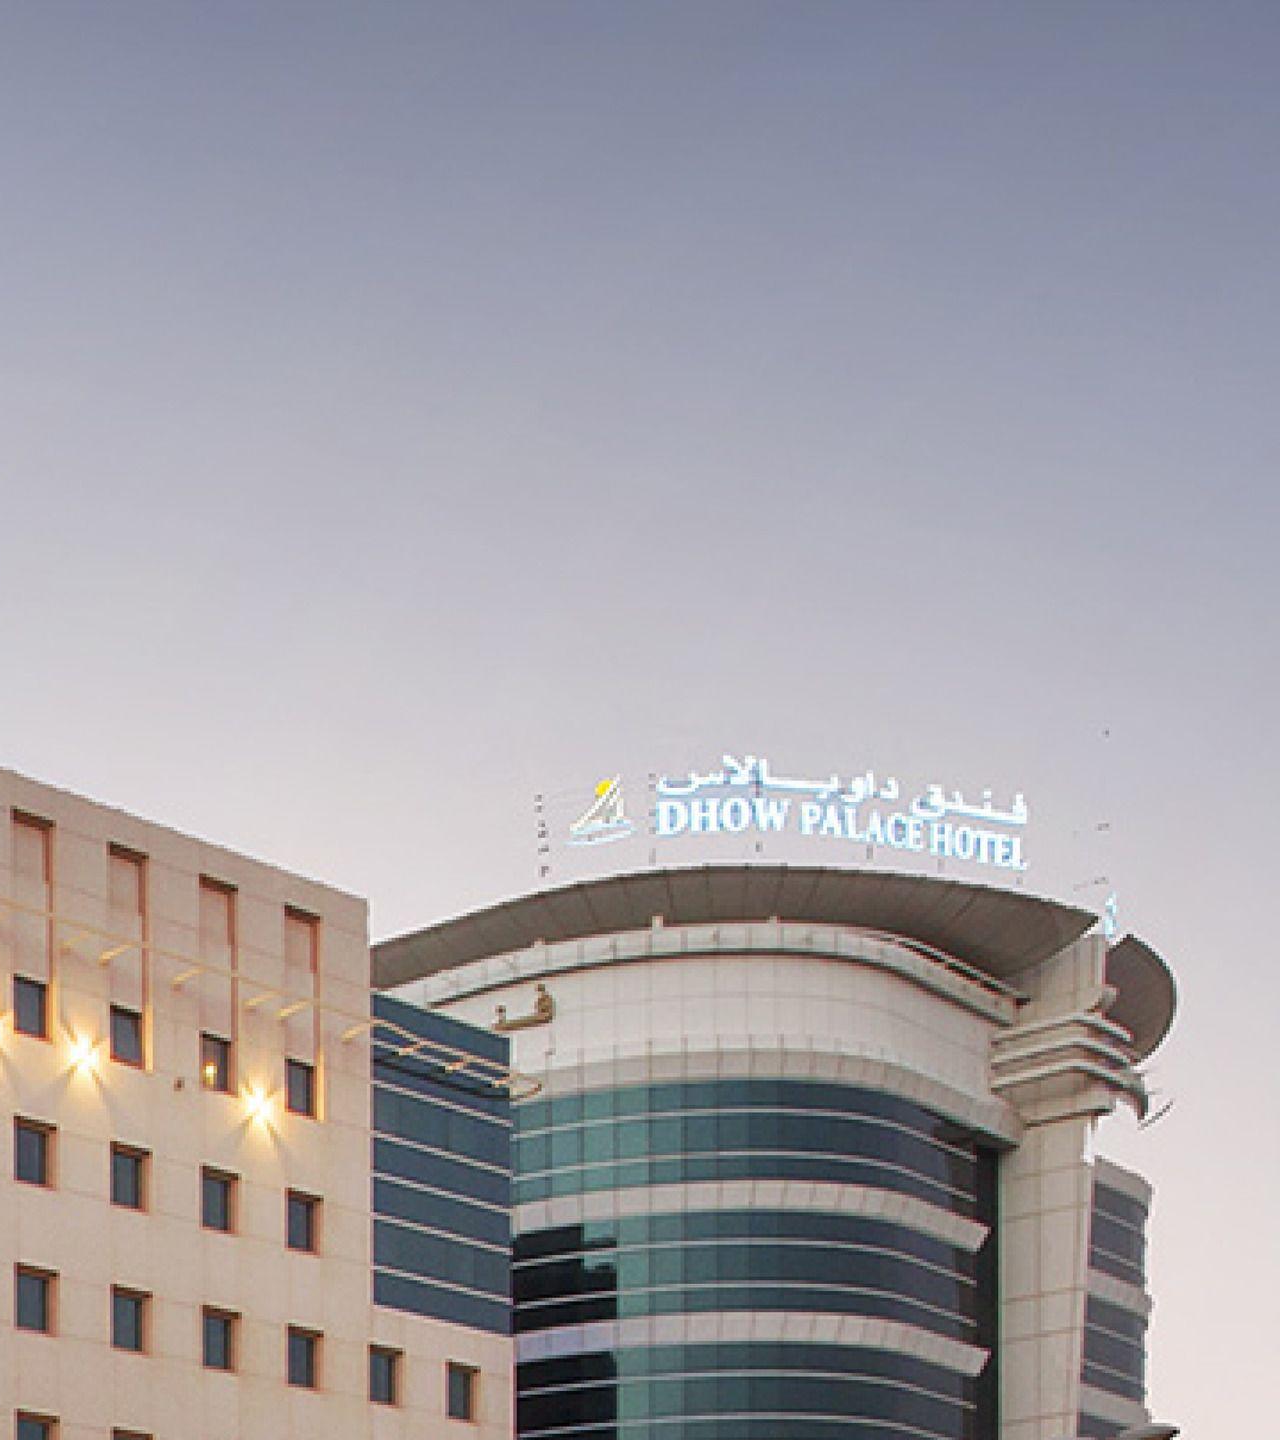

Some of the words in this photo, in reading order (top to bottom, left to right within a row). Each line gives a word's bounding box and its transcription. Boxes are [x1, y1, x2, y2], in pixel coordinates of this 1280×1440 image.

[655, 797, 792, 835] DHOW
[800, 801, 925, 850] PALACE
[928, 822, 1028, 871] HOTEL
